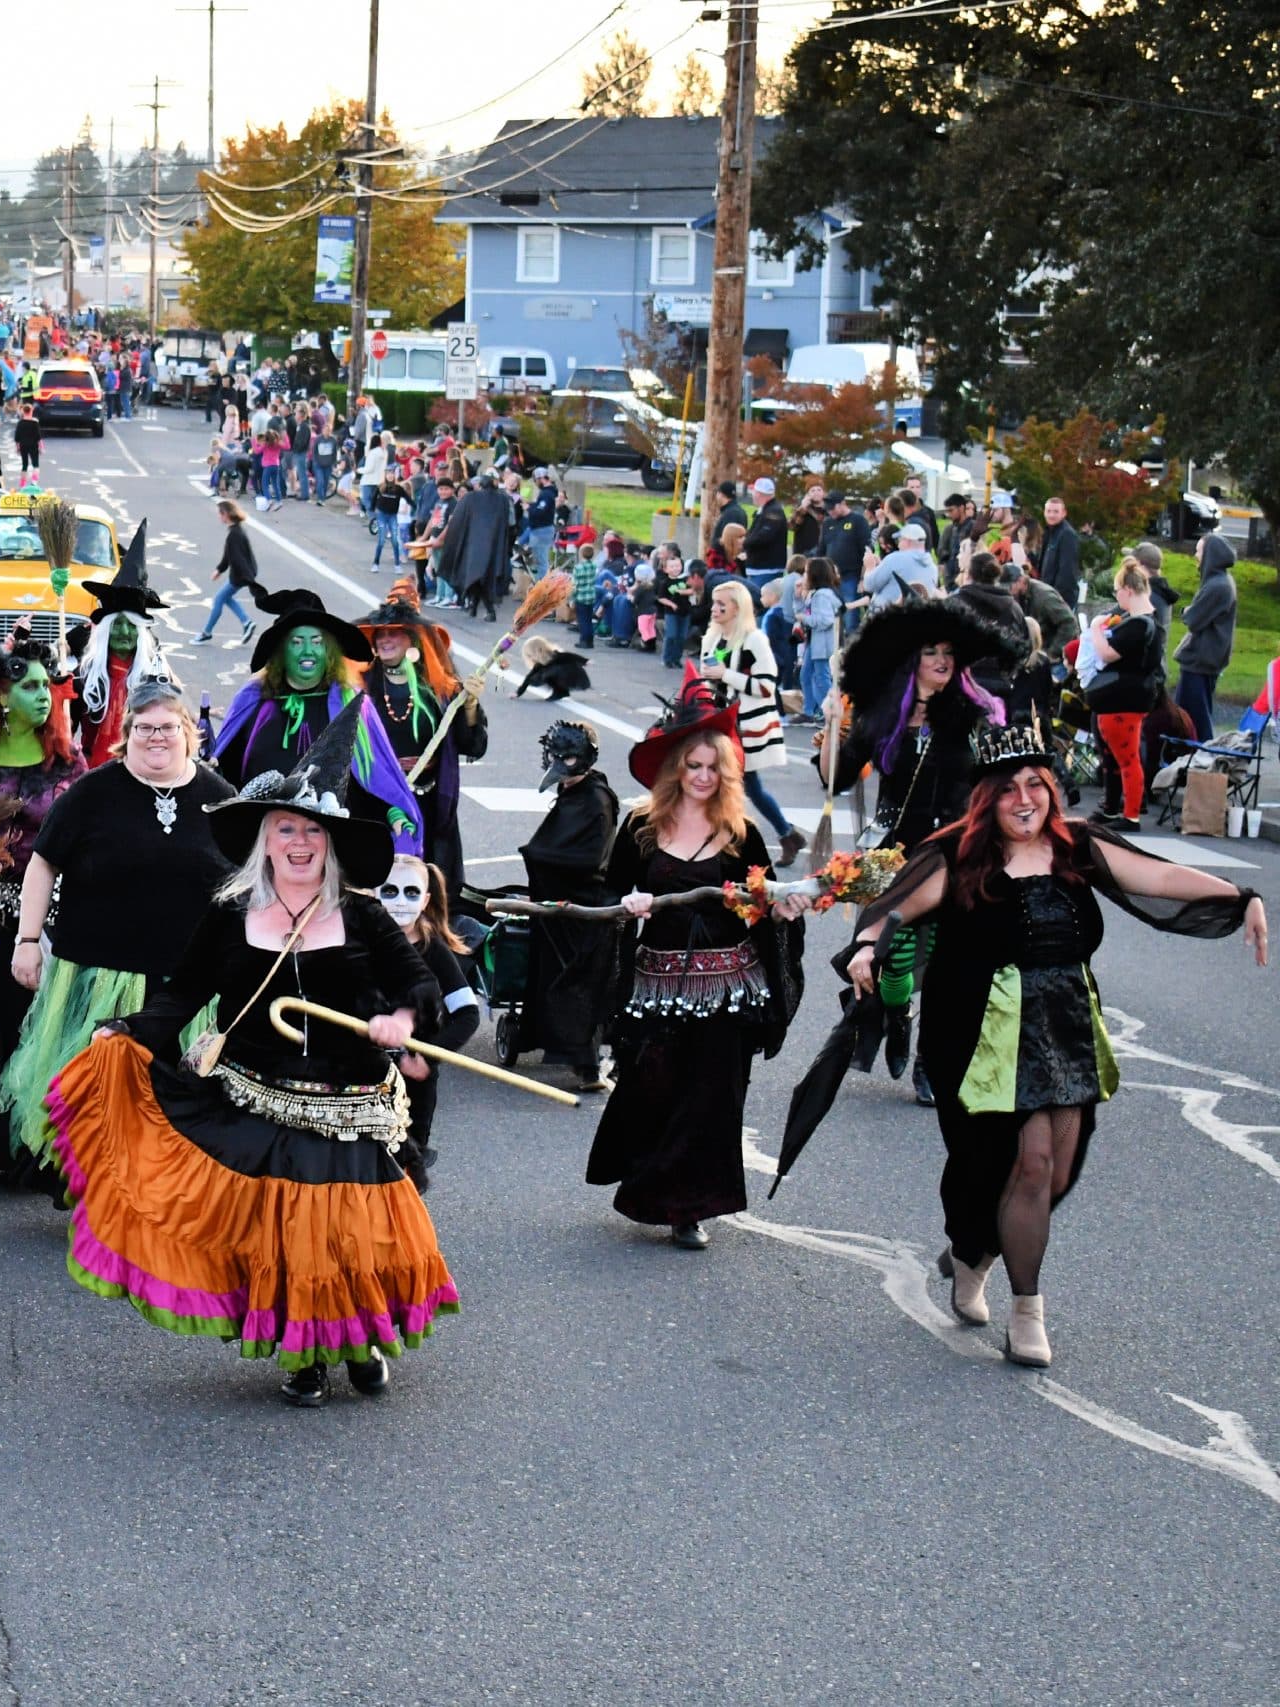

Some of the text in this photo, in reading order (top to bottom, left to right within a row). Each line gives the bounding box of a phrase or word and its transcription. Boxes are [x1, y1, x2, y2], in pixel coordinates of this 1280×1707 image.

[449, 327, 477, 335] SPEED
[371, 341, 387, 351] STOP
[450, 337, 476, 357] 25
